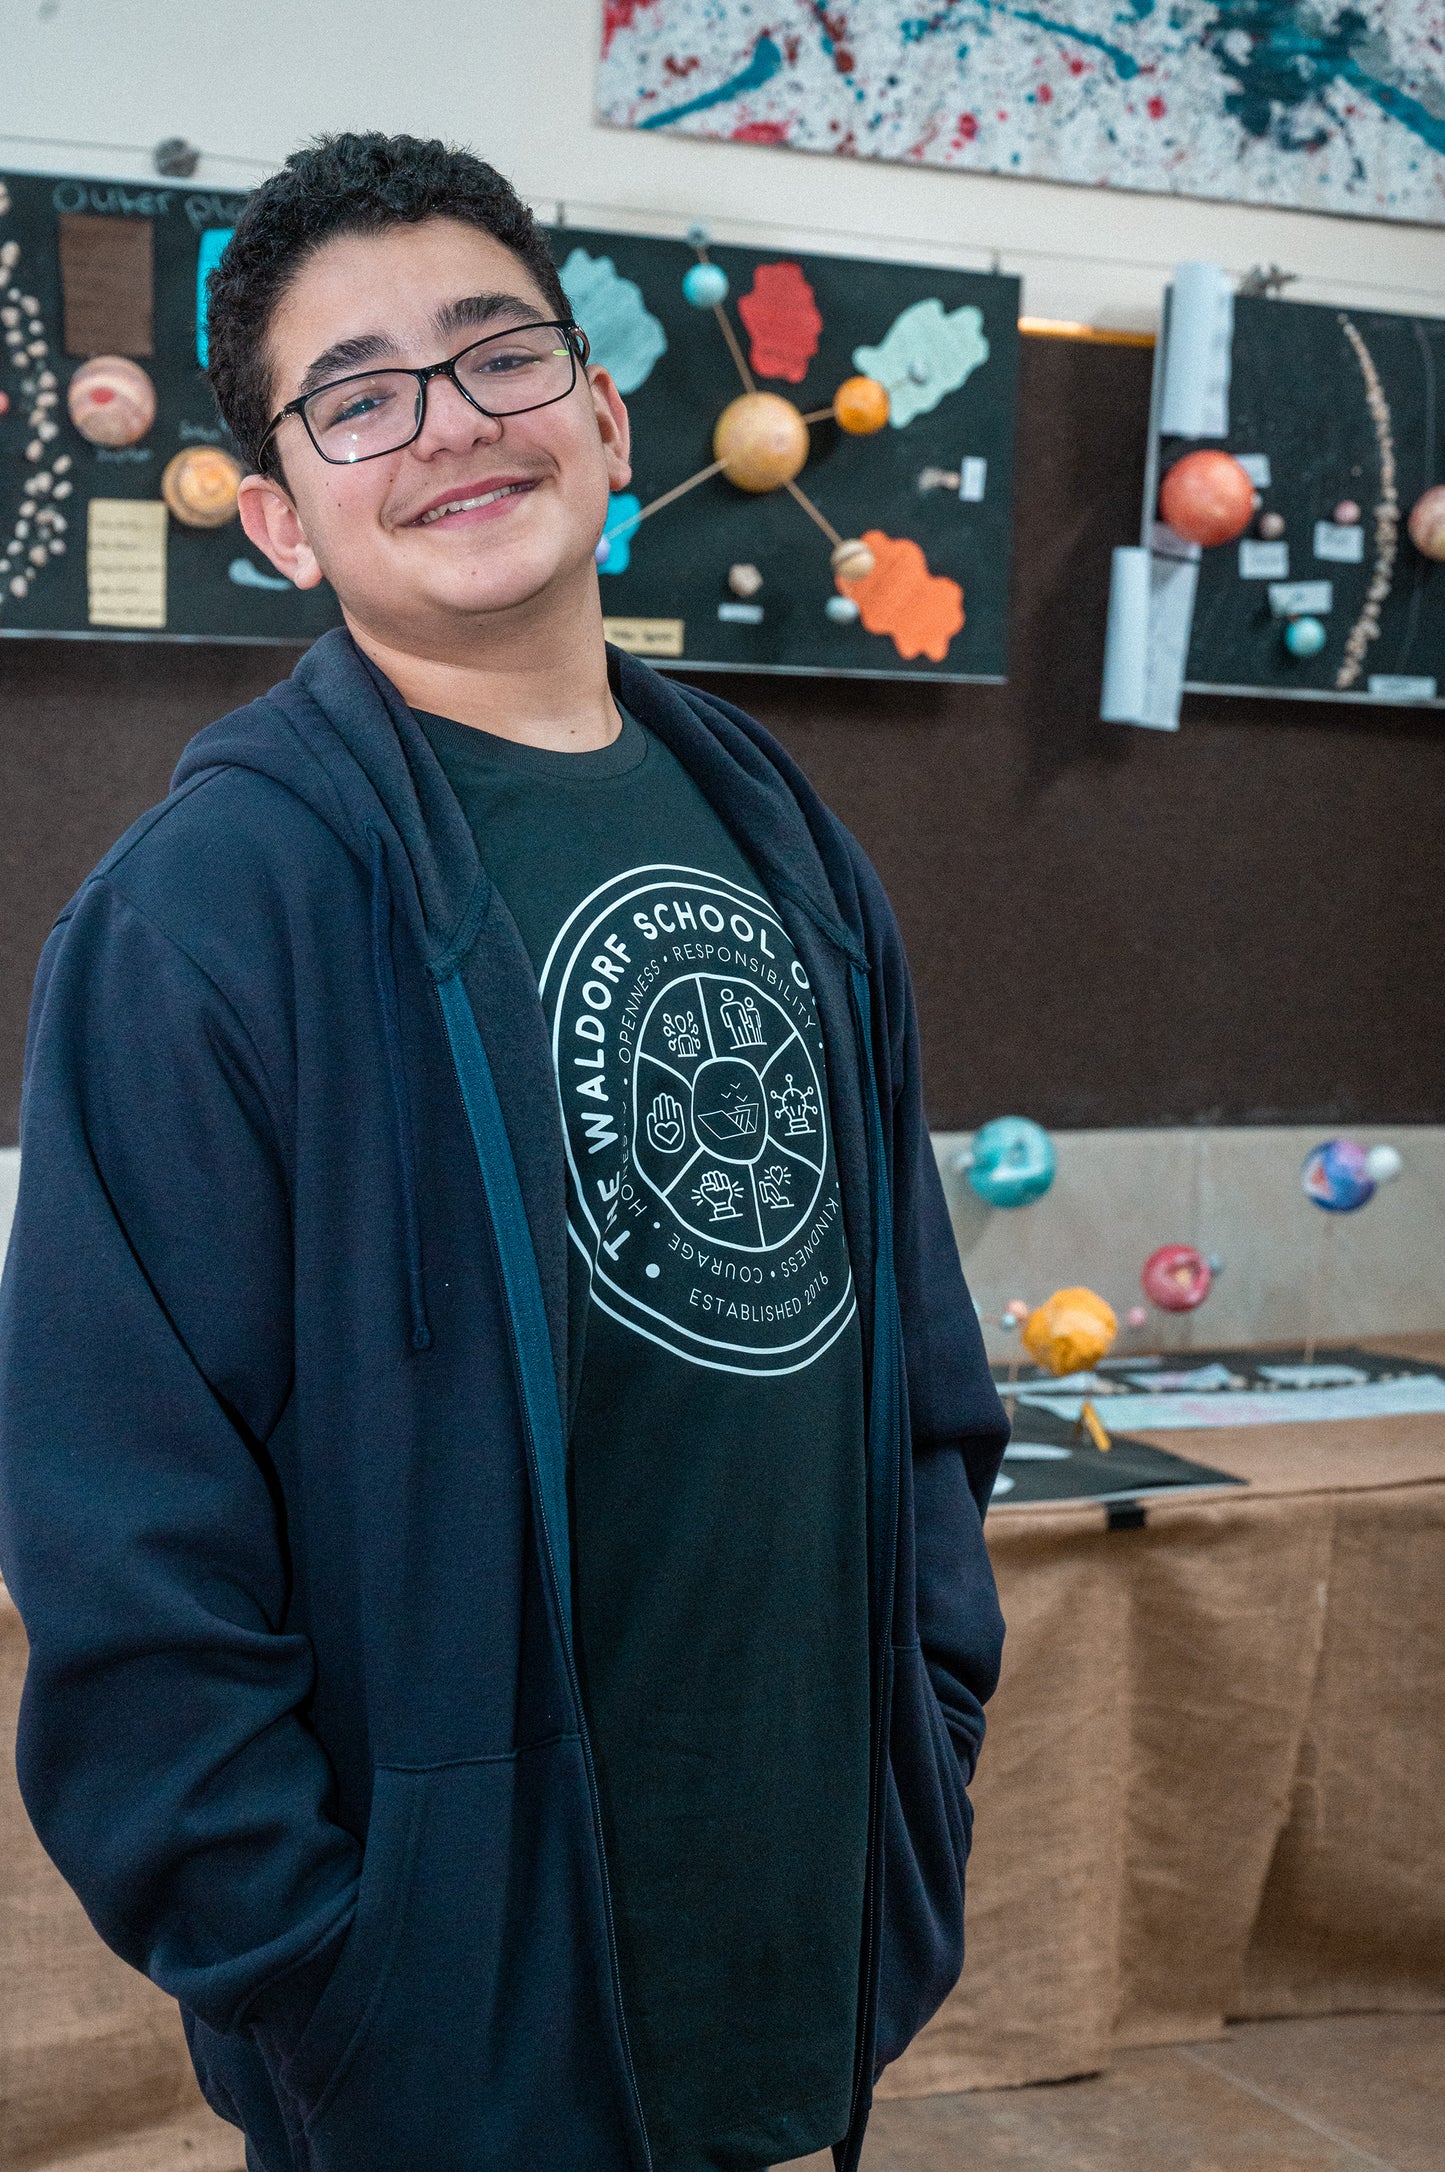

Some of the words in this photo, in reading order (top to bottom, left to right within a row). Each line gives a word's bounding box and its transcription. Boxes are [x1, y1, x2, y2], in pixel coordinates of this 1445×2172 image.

[574, 933, 632, 1155] WALDORF
[633, 901, 776, 960] SCHOOL
[618, 959, 660, 1064] OPENNESS
[672, 943, 817, 1029] RESPONSIBILITY
[667, 1232, 763, 1284] COURAGE
[780, 1196, 840, 1278] KINDNESS
[689, 1287, 802, 1323] ESTABLISHED
[804, 1270, 829, 1306] 2016
